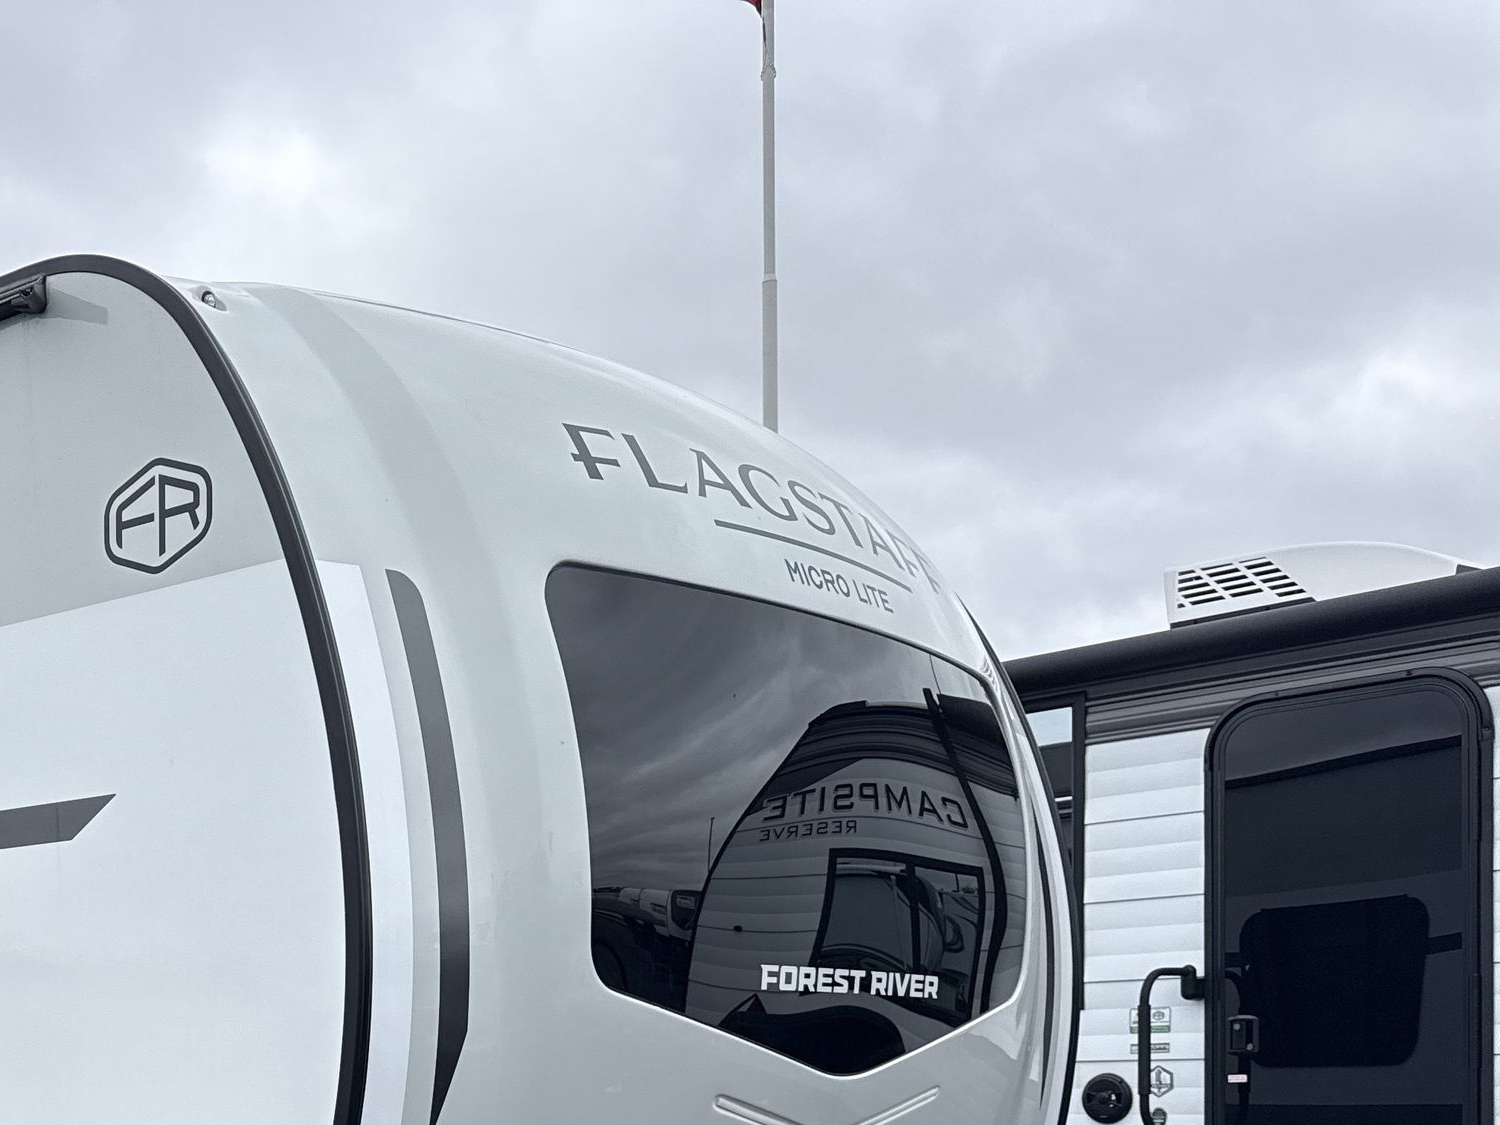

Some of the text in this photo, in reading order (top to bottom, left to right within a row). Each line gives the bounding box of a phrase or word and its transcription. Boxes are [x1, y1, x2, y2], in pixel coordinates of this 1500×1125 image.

[562, 422, 940, 595] FLAGSTAFF
[785, 558, 894, 613] MICRO LITE
[760, 963, 939, 1000] FOREST RIVER
